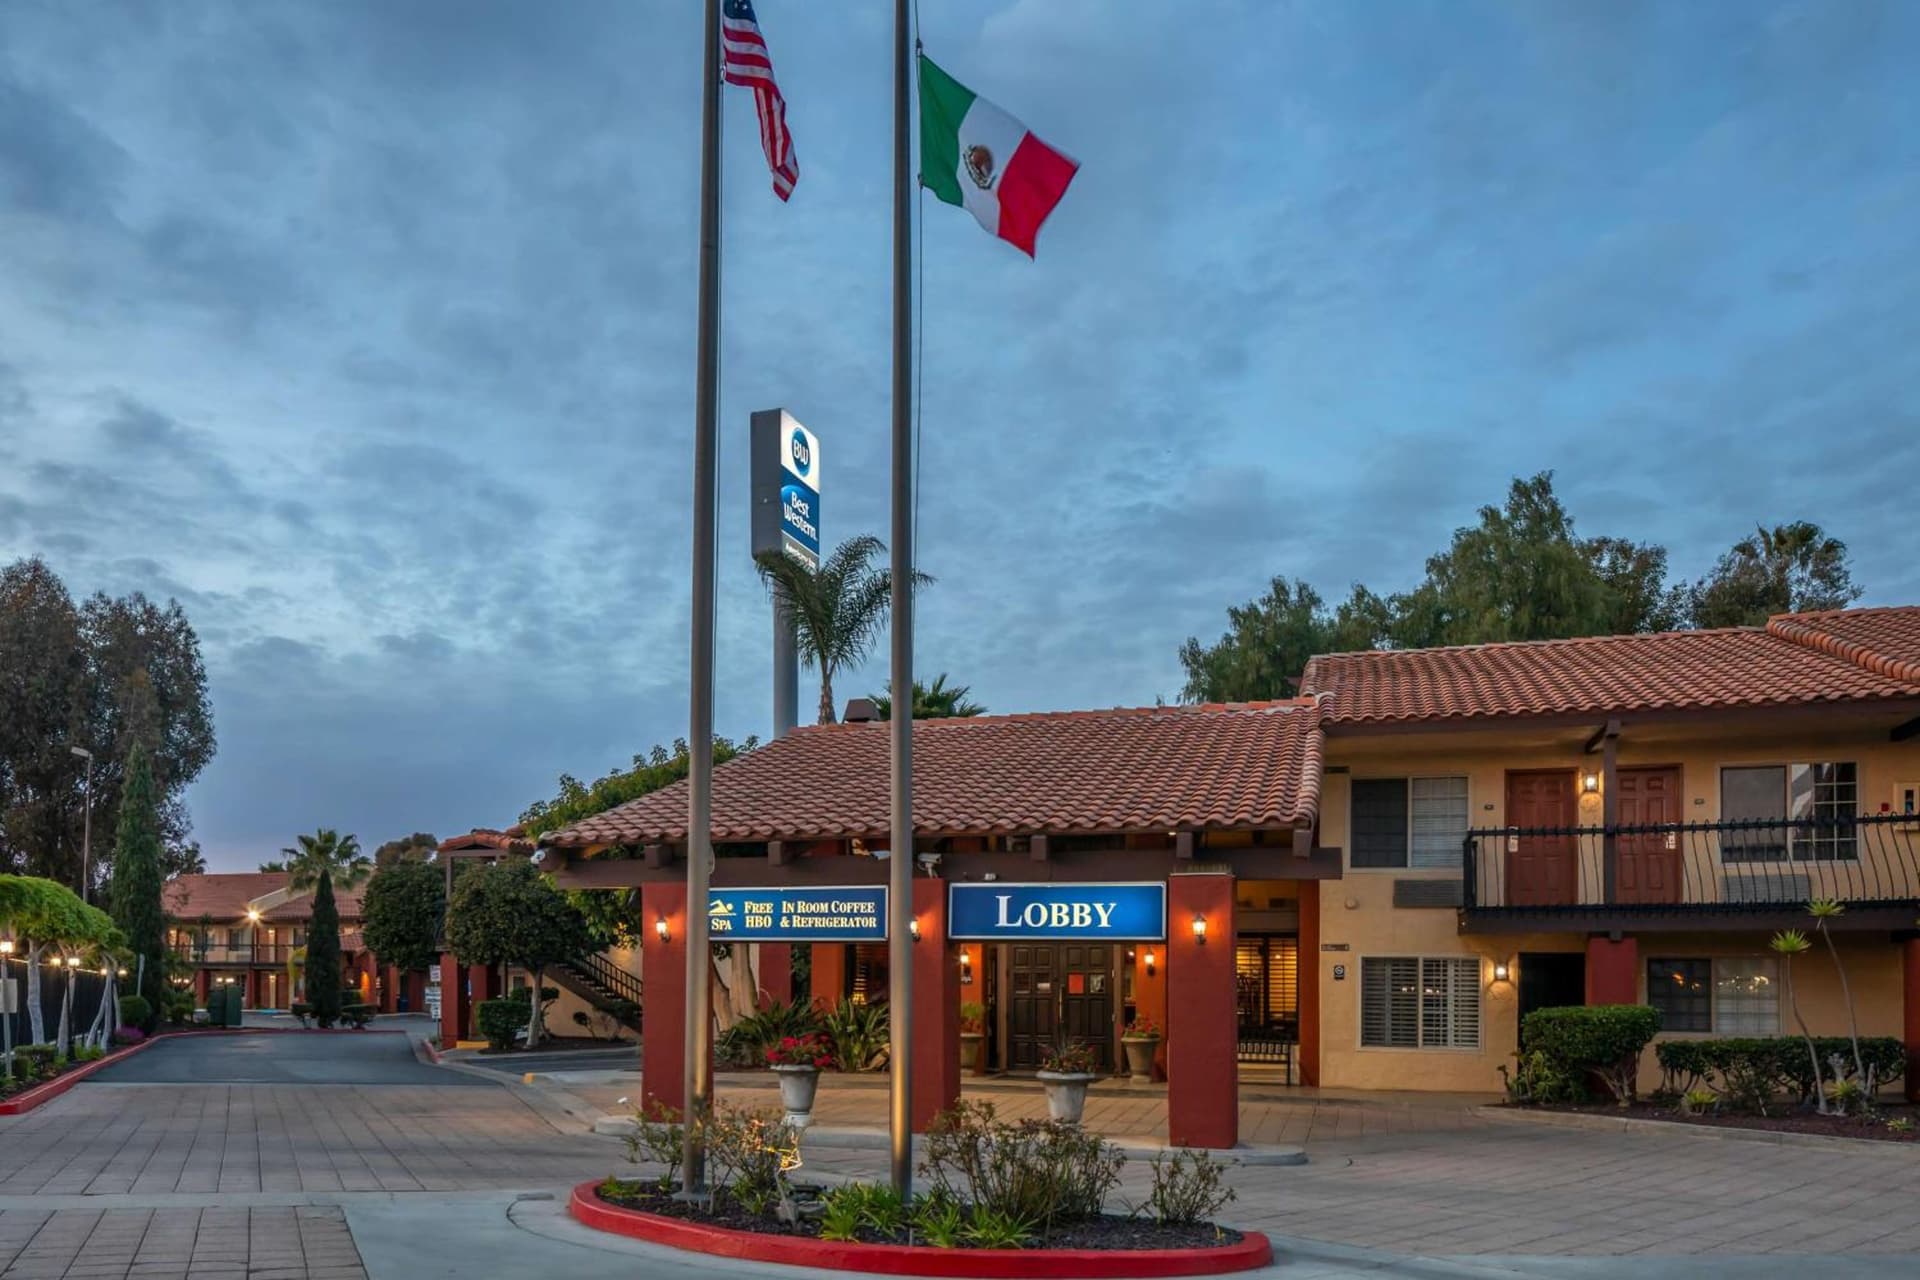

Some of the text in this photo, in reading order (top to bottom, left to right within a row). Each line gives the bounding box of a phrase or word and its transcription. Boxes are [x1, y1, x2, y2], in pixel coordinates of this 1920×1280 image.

[793, 439, 809, 466] BW
[791, 491, 810, 518] Best
[783, 502, 816, 541] Western
[743, 901, 875, 914] FREE IN ROOM COFFEE
[994, 895, 1117, 928] LOBBY
[711, 918, 732, 930] SPA
[745, 915, 877, 928] HBO & REFRIGERATOR
